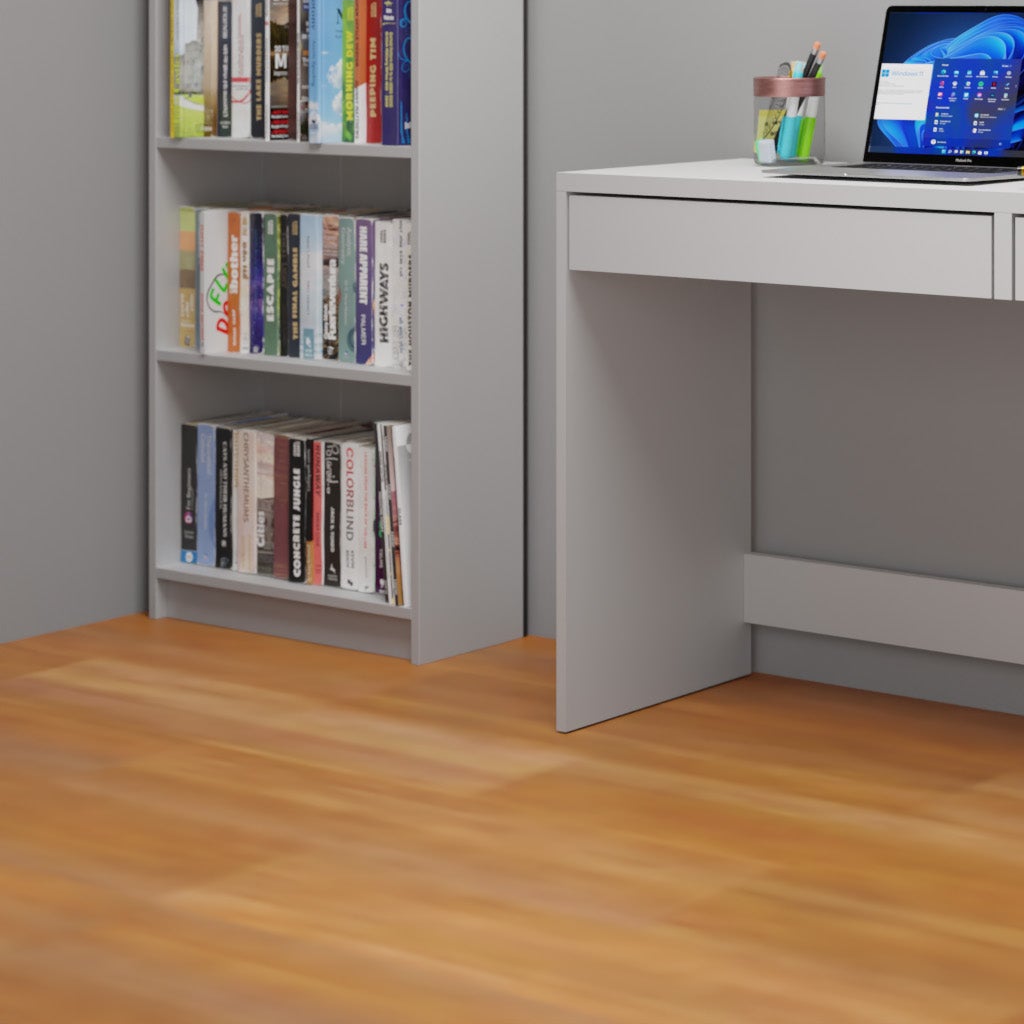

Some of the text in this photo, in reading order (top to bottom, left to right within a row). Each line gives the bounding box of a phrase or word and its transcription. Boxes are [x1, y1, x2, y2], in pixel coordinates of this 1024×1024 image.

[346, 30, 354, 122] MORNING DEW
[358, 254, 367, 306] APPARENT
[359, 225, 368, 253] HARE
[379, 262, 389, 344] HIGHWAYS
[292, 467, 302, 578] CONCRETE JUNGLE
[346, 447, 354, 541] COLORBLIND
